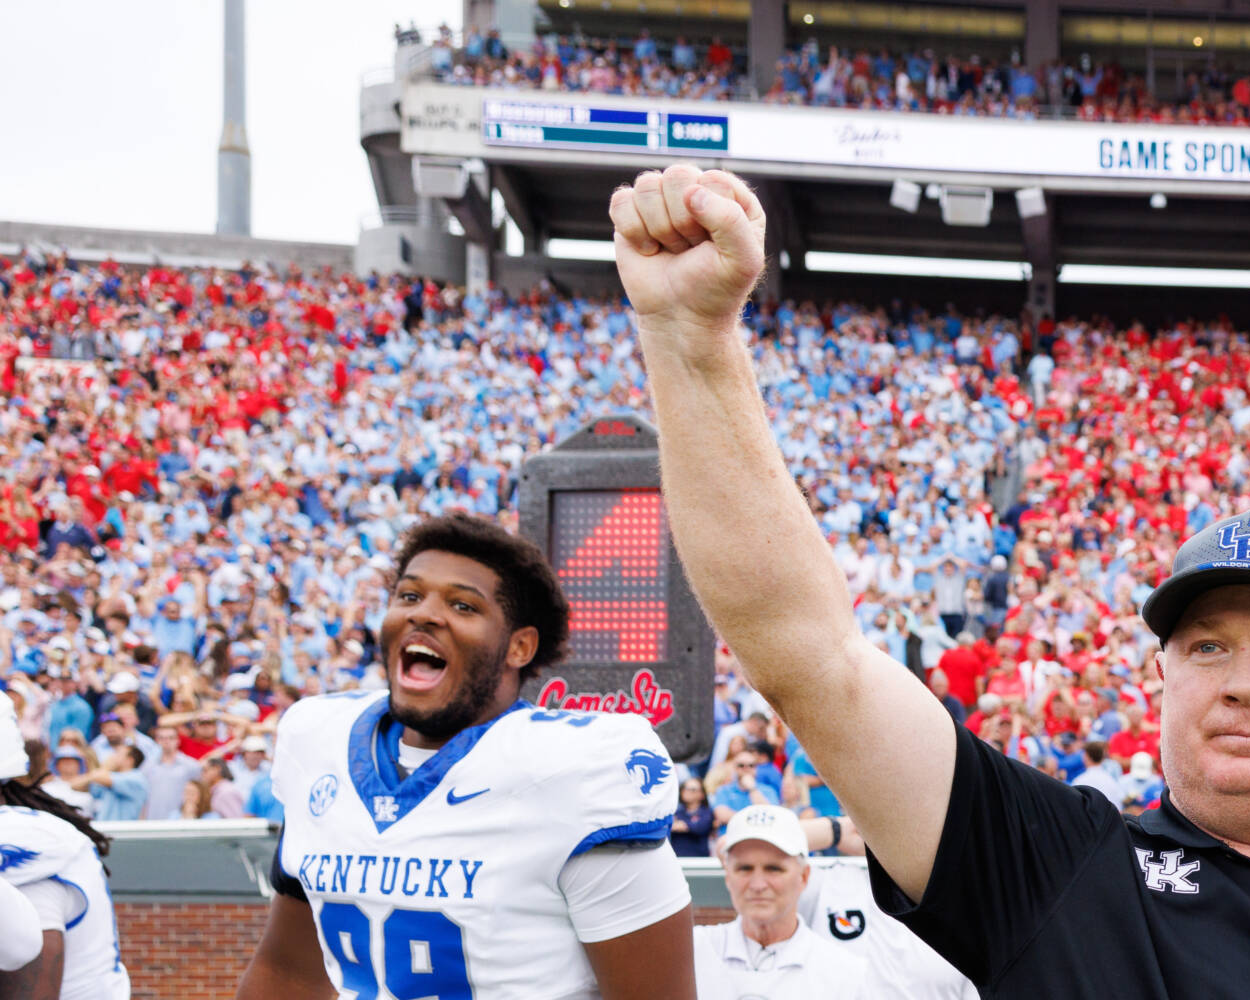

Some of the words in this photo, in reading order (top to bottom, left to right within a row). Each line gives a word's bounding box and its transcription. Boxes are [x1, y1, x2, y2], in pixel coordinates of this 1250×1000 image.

[1099, 138, 1172, 171] GAME
[557, 494, 667, 661] 4
[299, 853, 483, 899] KENTUCKY
[1134, 846, 1201, 894] UK
